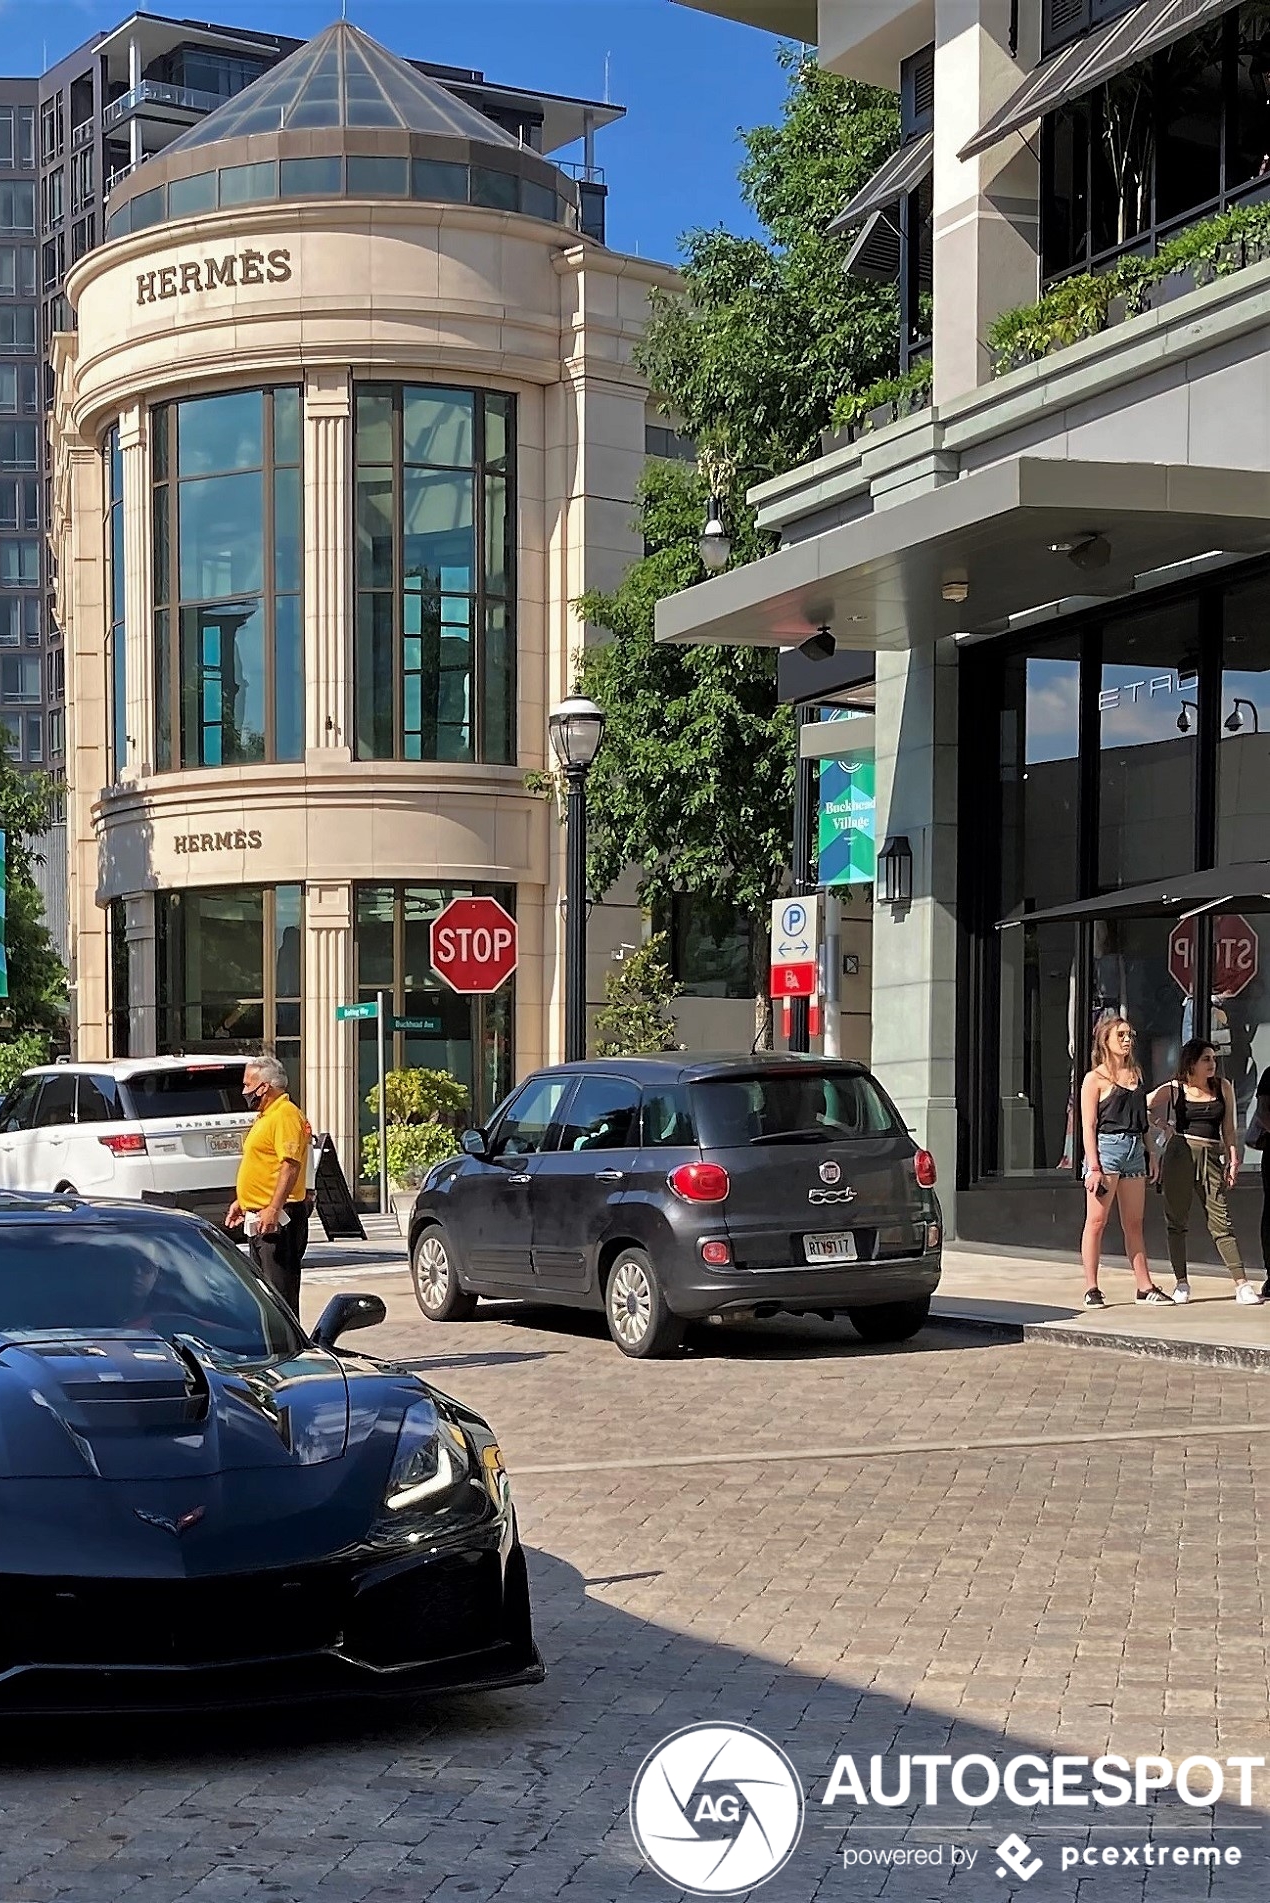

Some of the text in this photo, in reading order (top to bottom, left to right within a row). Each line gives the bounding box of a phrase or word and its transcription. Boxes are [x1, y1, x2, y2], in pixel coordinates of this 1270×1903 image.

[136, 248, 292, 305] HERMÈS
[825, 797, 877, 815] Buckhead
[833, 816, 870, 831] Village
[173, 828, 263, 855] HERMÈS
[437, 927, 512, 963] STOP
